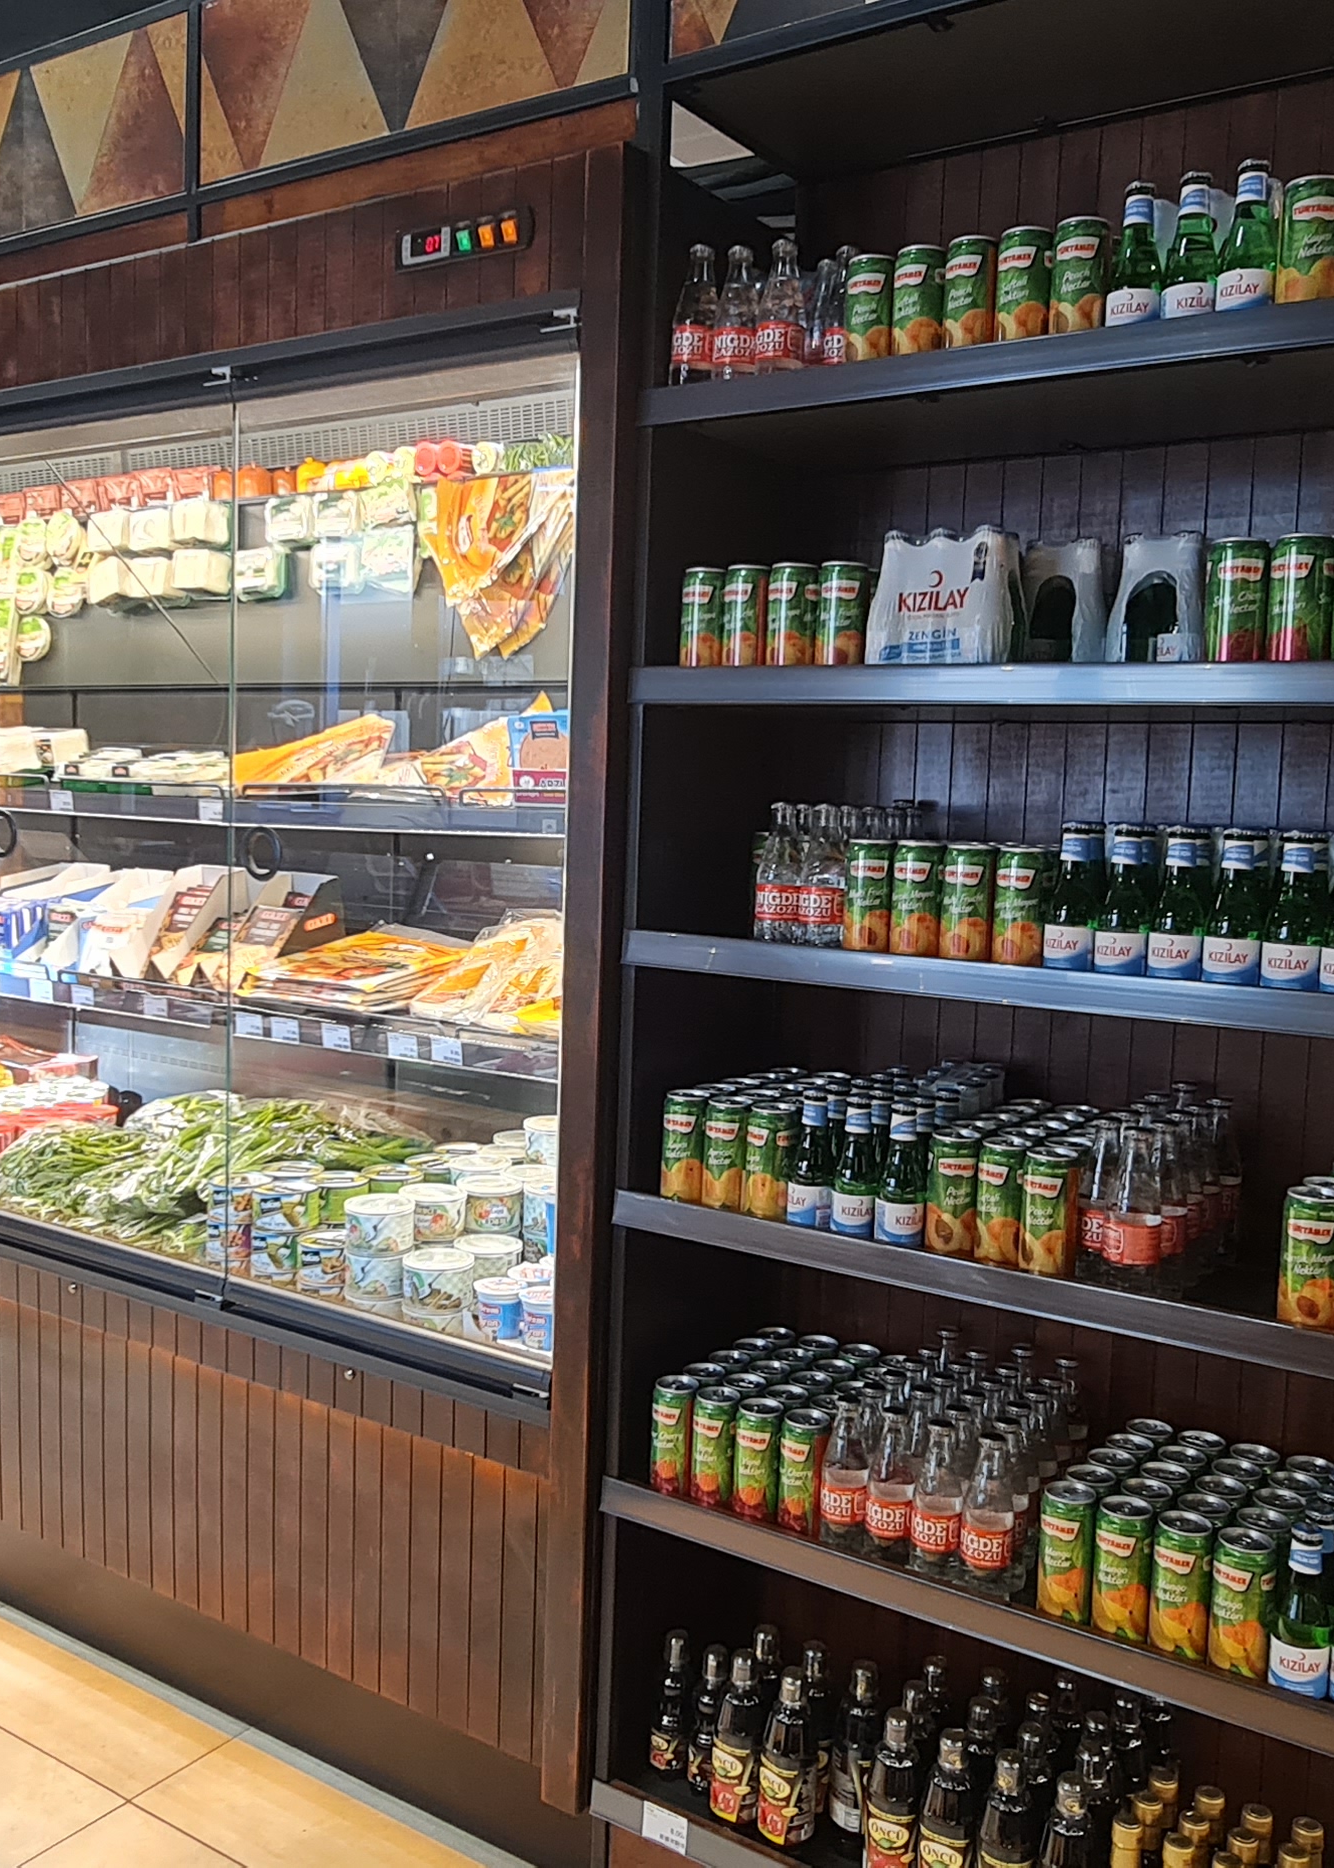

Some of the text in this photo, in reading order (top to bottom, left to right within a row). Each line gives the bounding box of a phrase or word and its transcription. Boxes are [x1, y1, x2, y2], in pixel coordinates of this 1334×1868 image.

[1177, 297, 1212, 309] KIZILA
[898, 587, 969, 612] KIZILAY
[1152, 947, 1190, 960] KIZILAY
[1209, 952, 1249, 964] KIZILAY
[1268, 958, 1309, 970] KIZILAY
[1279, 1656, 1321, 1673] KIZILAY
